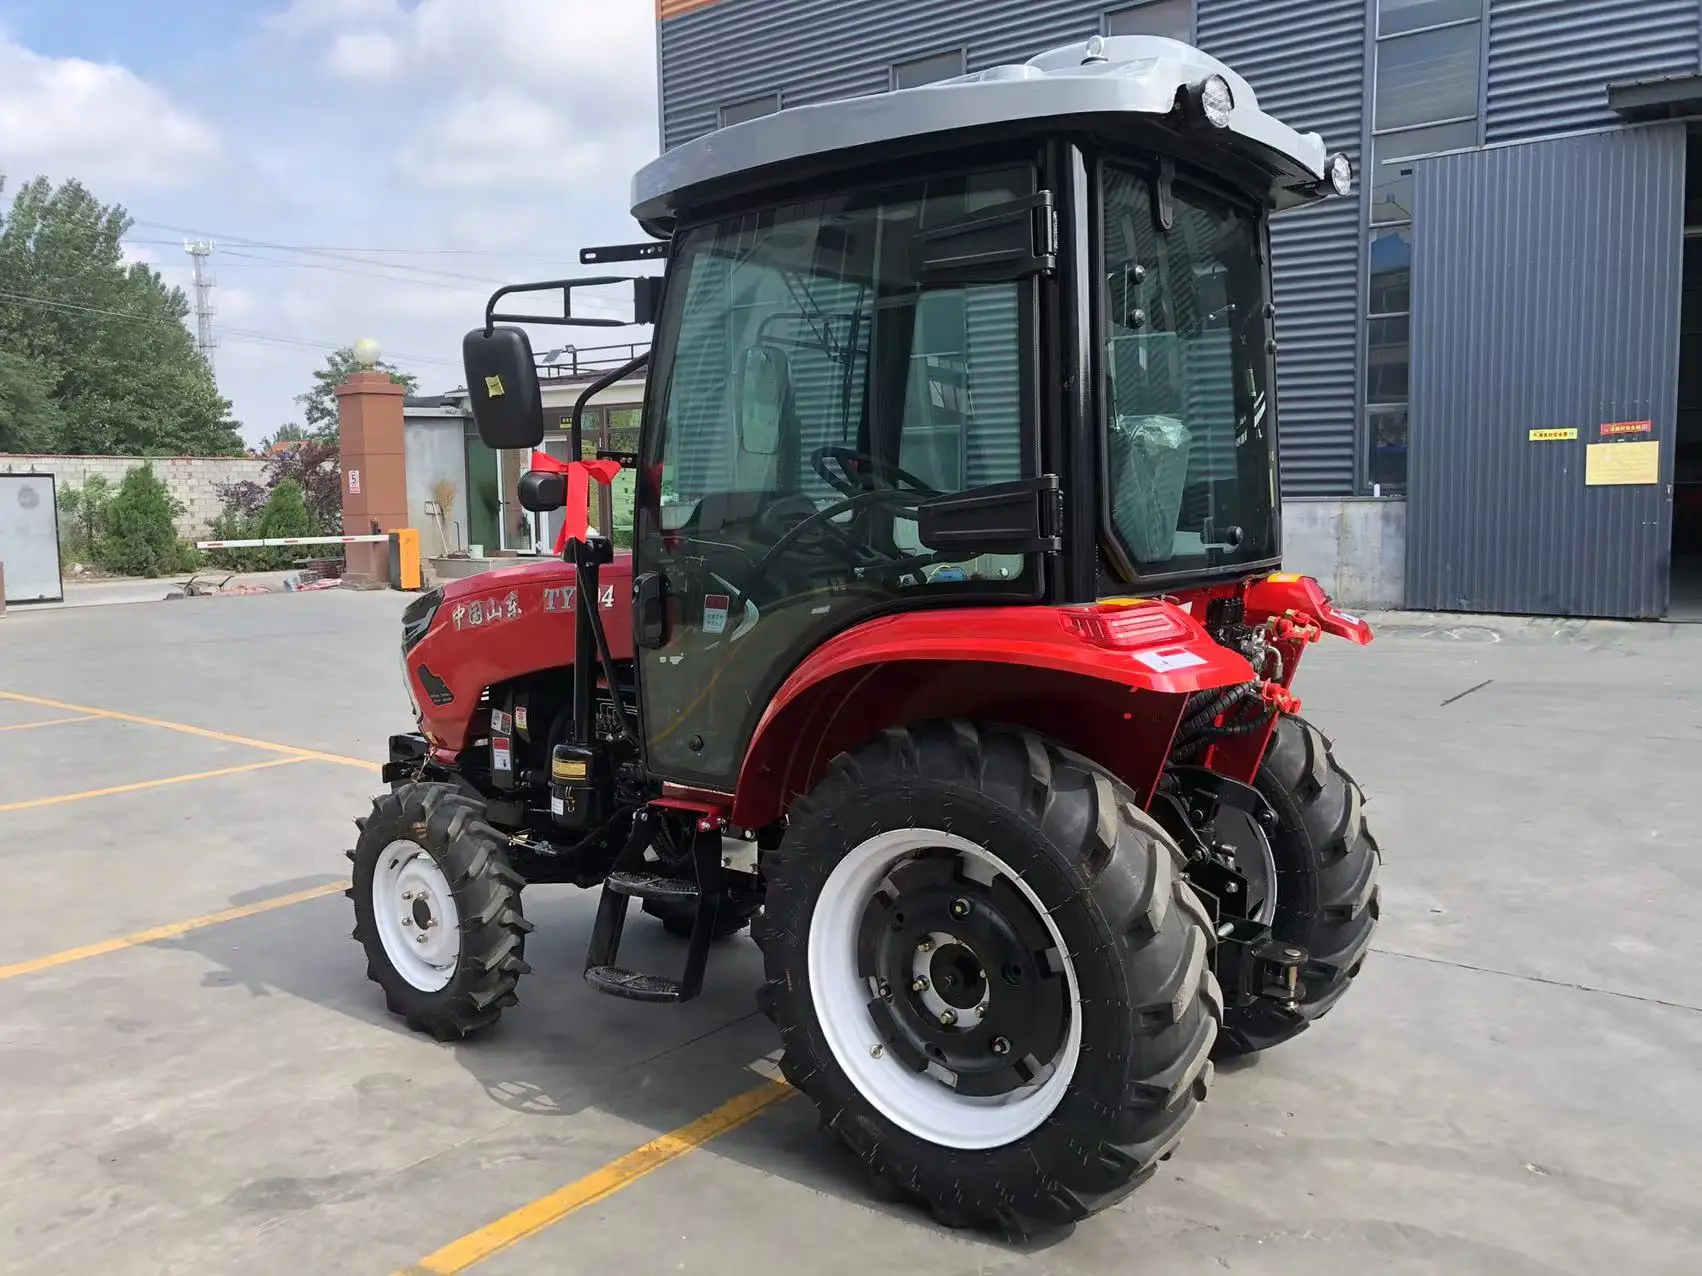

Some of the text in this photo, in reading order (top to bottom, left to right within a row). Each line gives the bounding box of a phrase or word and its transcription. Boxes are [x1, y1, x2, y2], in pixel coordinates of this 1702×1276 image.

[452, 591, 523, 631] 中国山东
[544, 585, 614, 612] TY4
